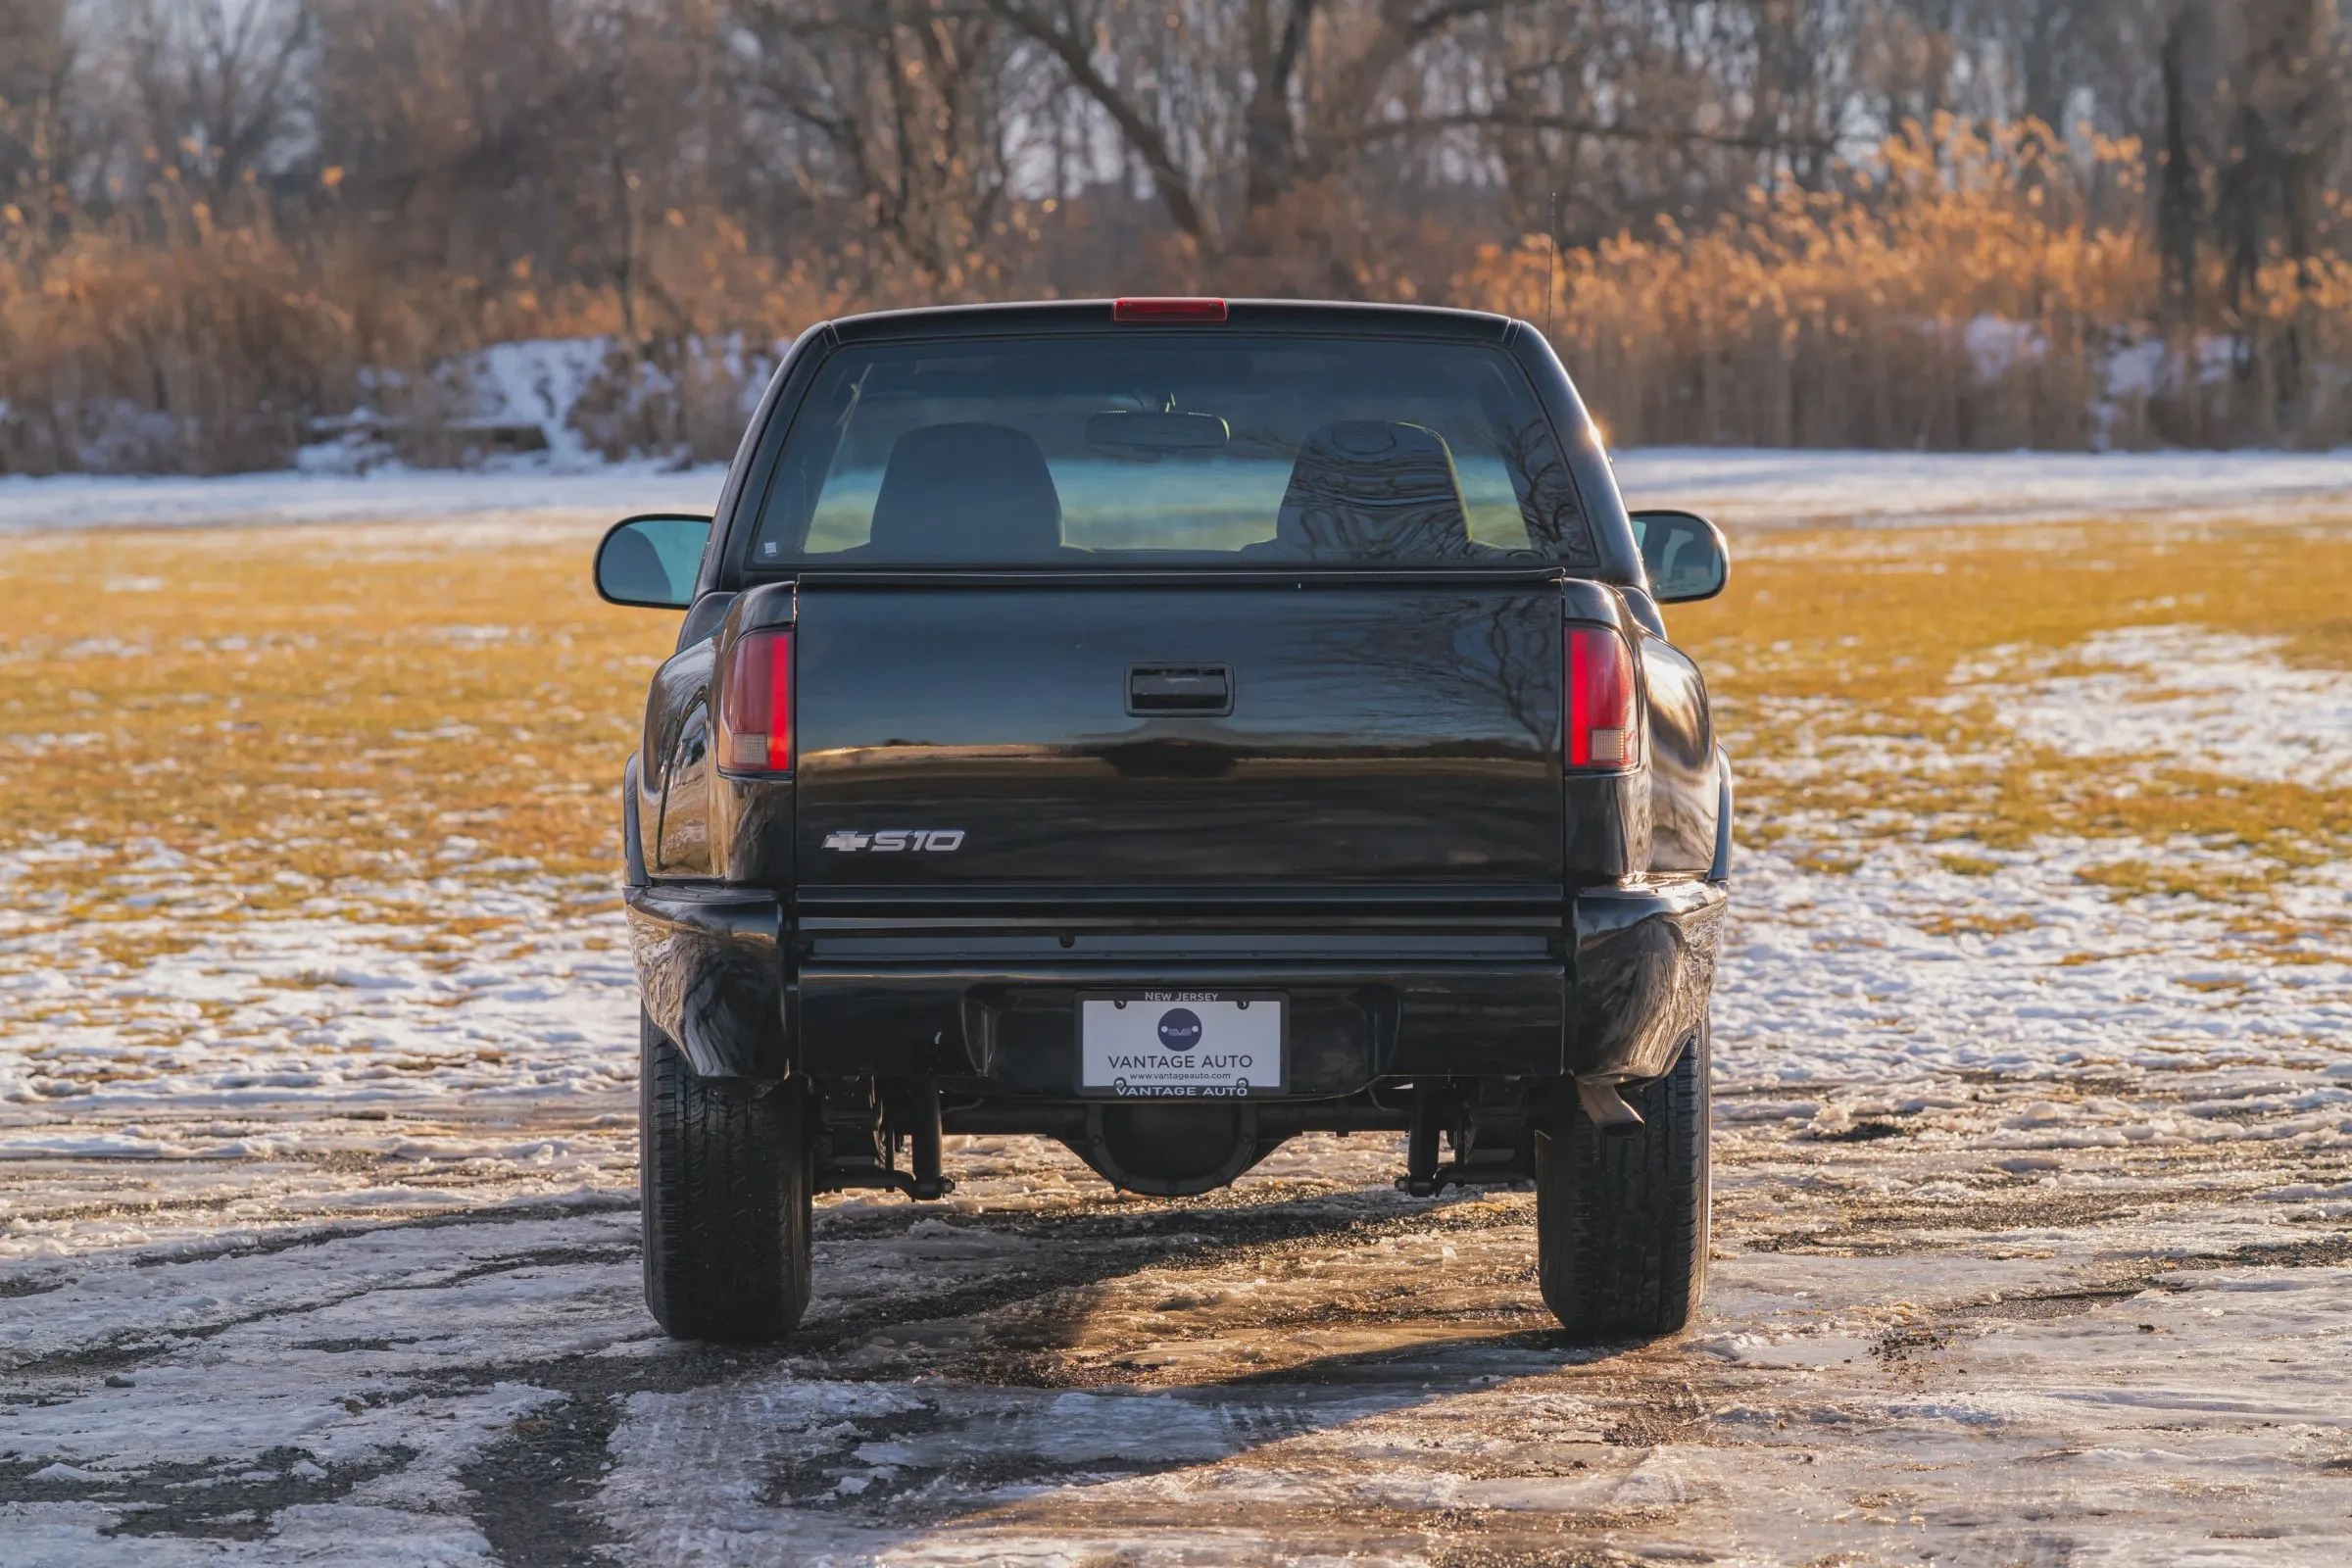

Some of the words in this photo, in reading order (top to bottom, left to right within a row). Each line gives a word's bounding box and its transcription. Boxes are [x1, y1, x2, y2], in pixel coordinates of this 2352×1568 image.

[871, 830, 965, 852] S10
[1145, 992, 1172, 1002] NEW
[1176, 992, 1218, 1002] JERSEY
[1108, 1055, 1195, 1068] VANTAGE
[1201, 1055, 1252, 1068] AUTO
[1130, 1072, 1231, 1081] www.vantageauto.com
[1116, 1087, 1197, 1096] VANTAGE
[1202, 1087, 1248, 1096] AUTO
